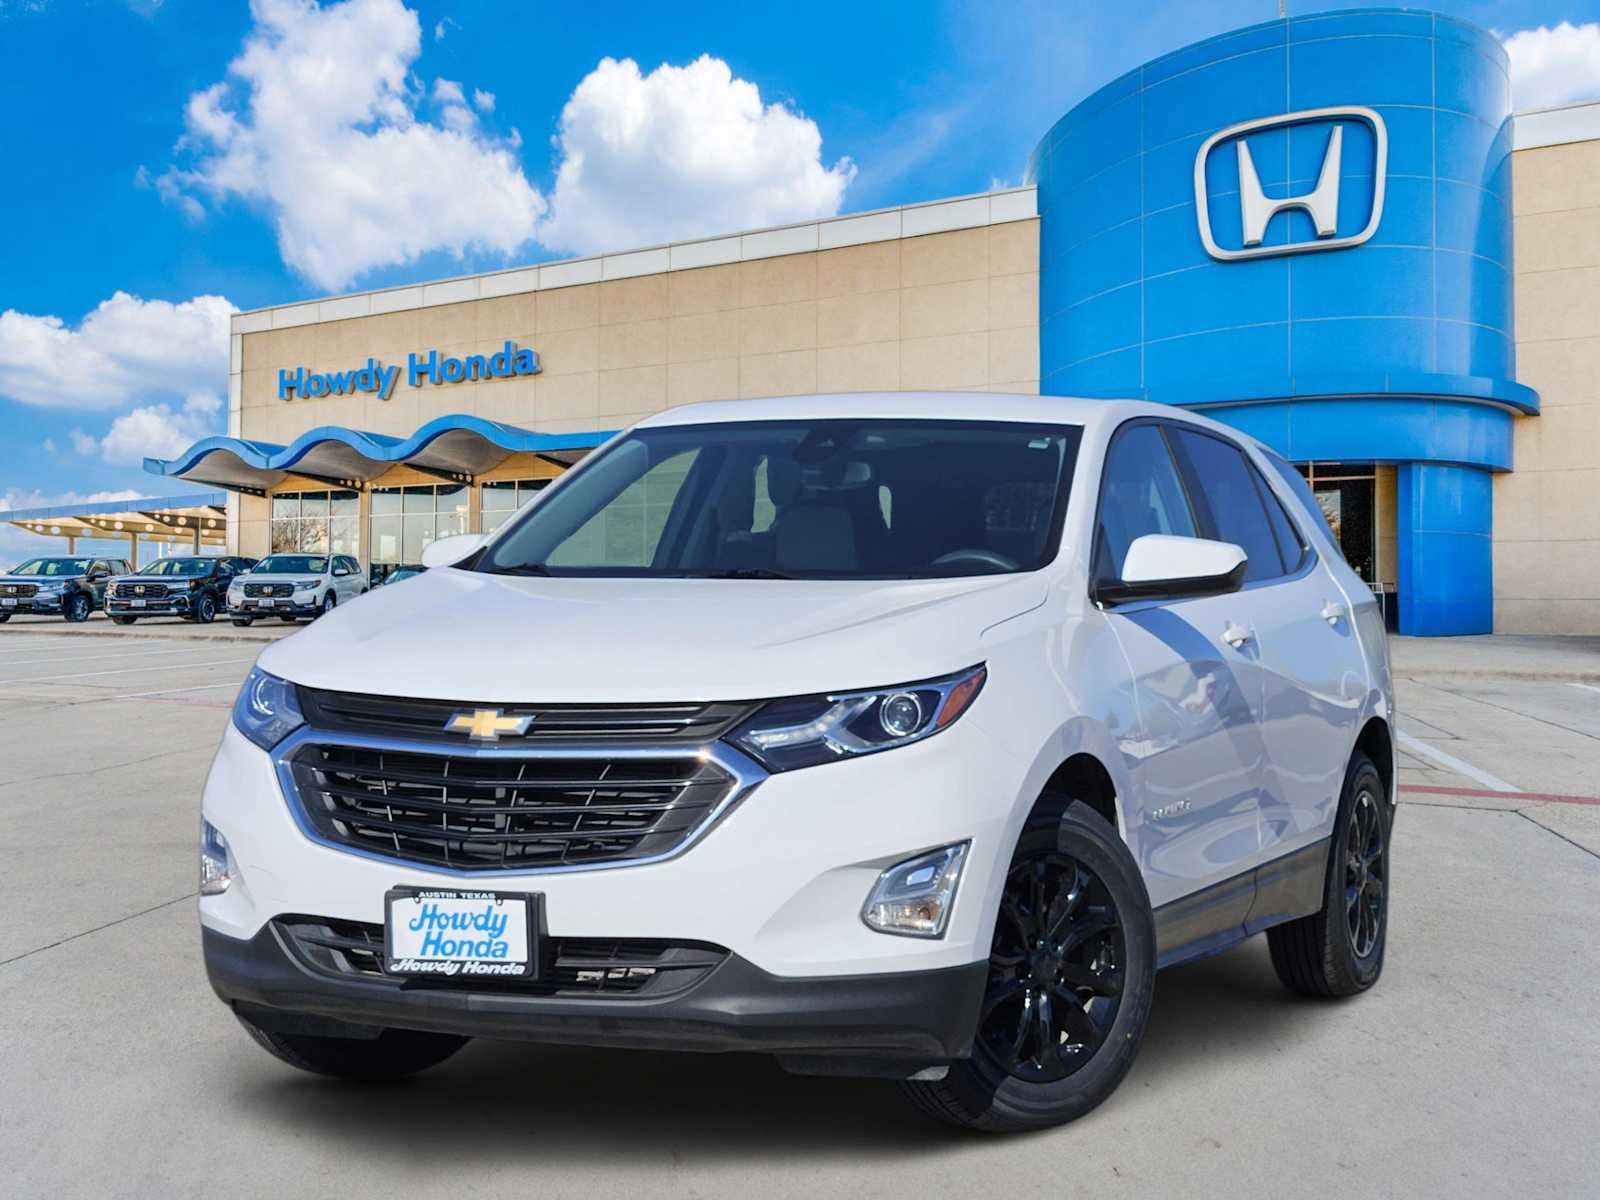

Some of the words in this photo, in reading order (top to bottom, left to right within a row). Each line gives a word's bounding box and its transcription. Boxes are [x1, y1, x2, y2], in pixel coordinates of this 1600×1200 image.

[278, 357, 401, 401] Howdy
[407, 340, 542, 388] Honda
[418, 891, 457, 899] AUSTIN
[460, 892, 496, 900] TEXAS
[409, 903, 508, 939] Howdy
[419, 931, 509, 959] Honda
[390, 958, 461, 976] Howdy
[462, 961, 526, 975] Honda
